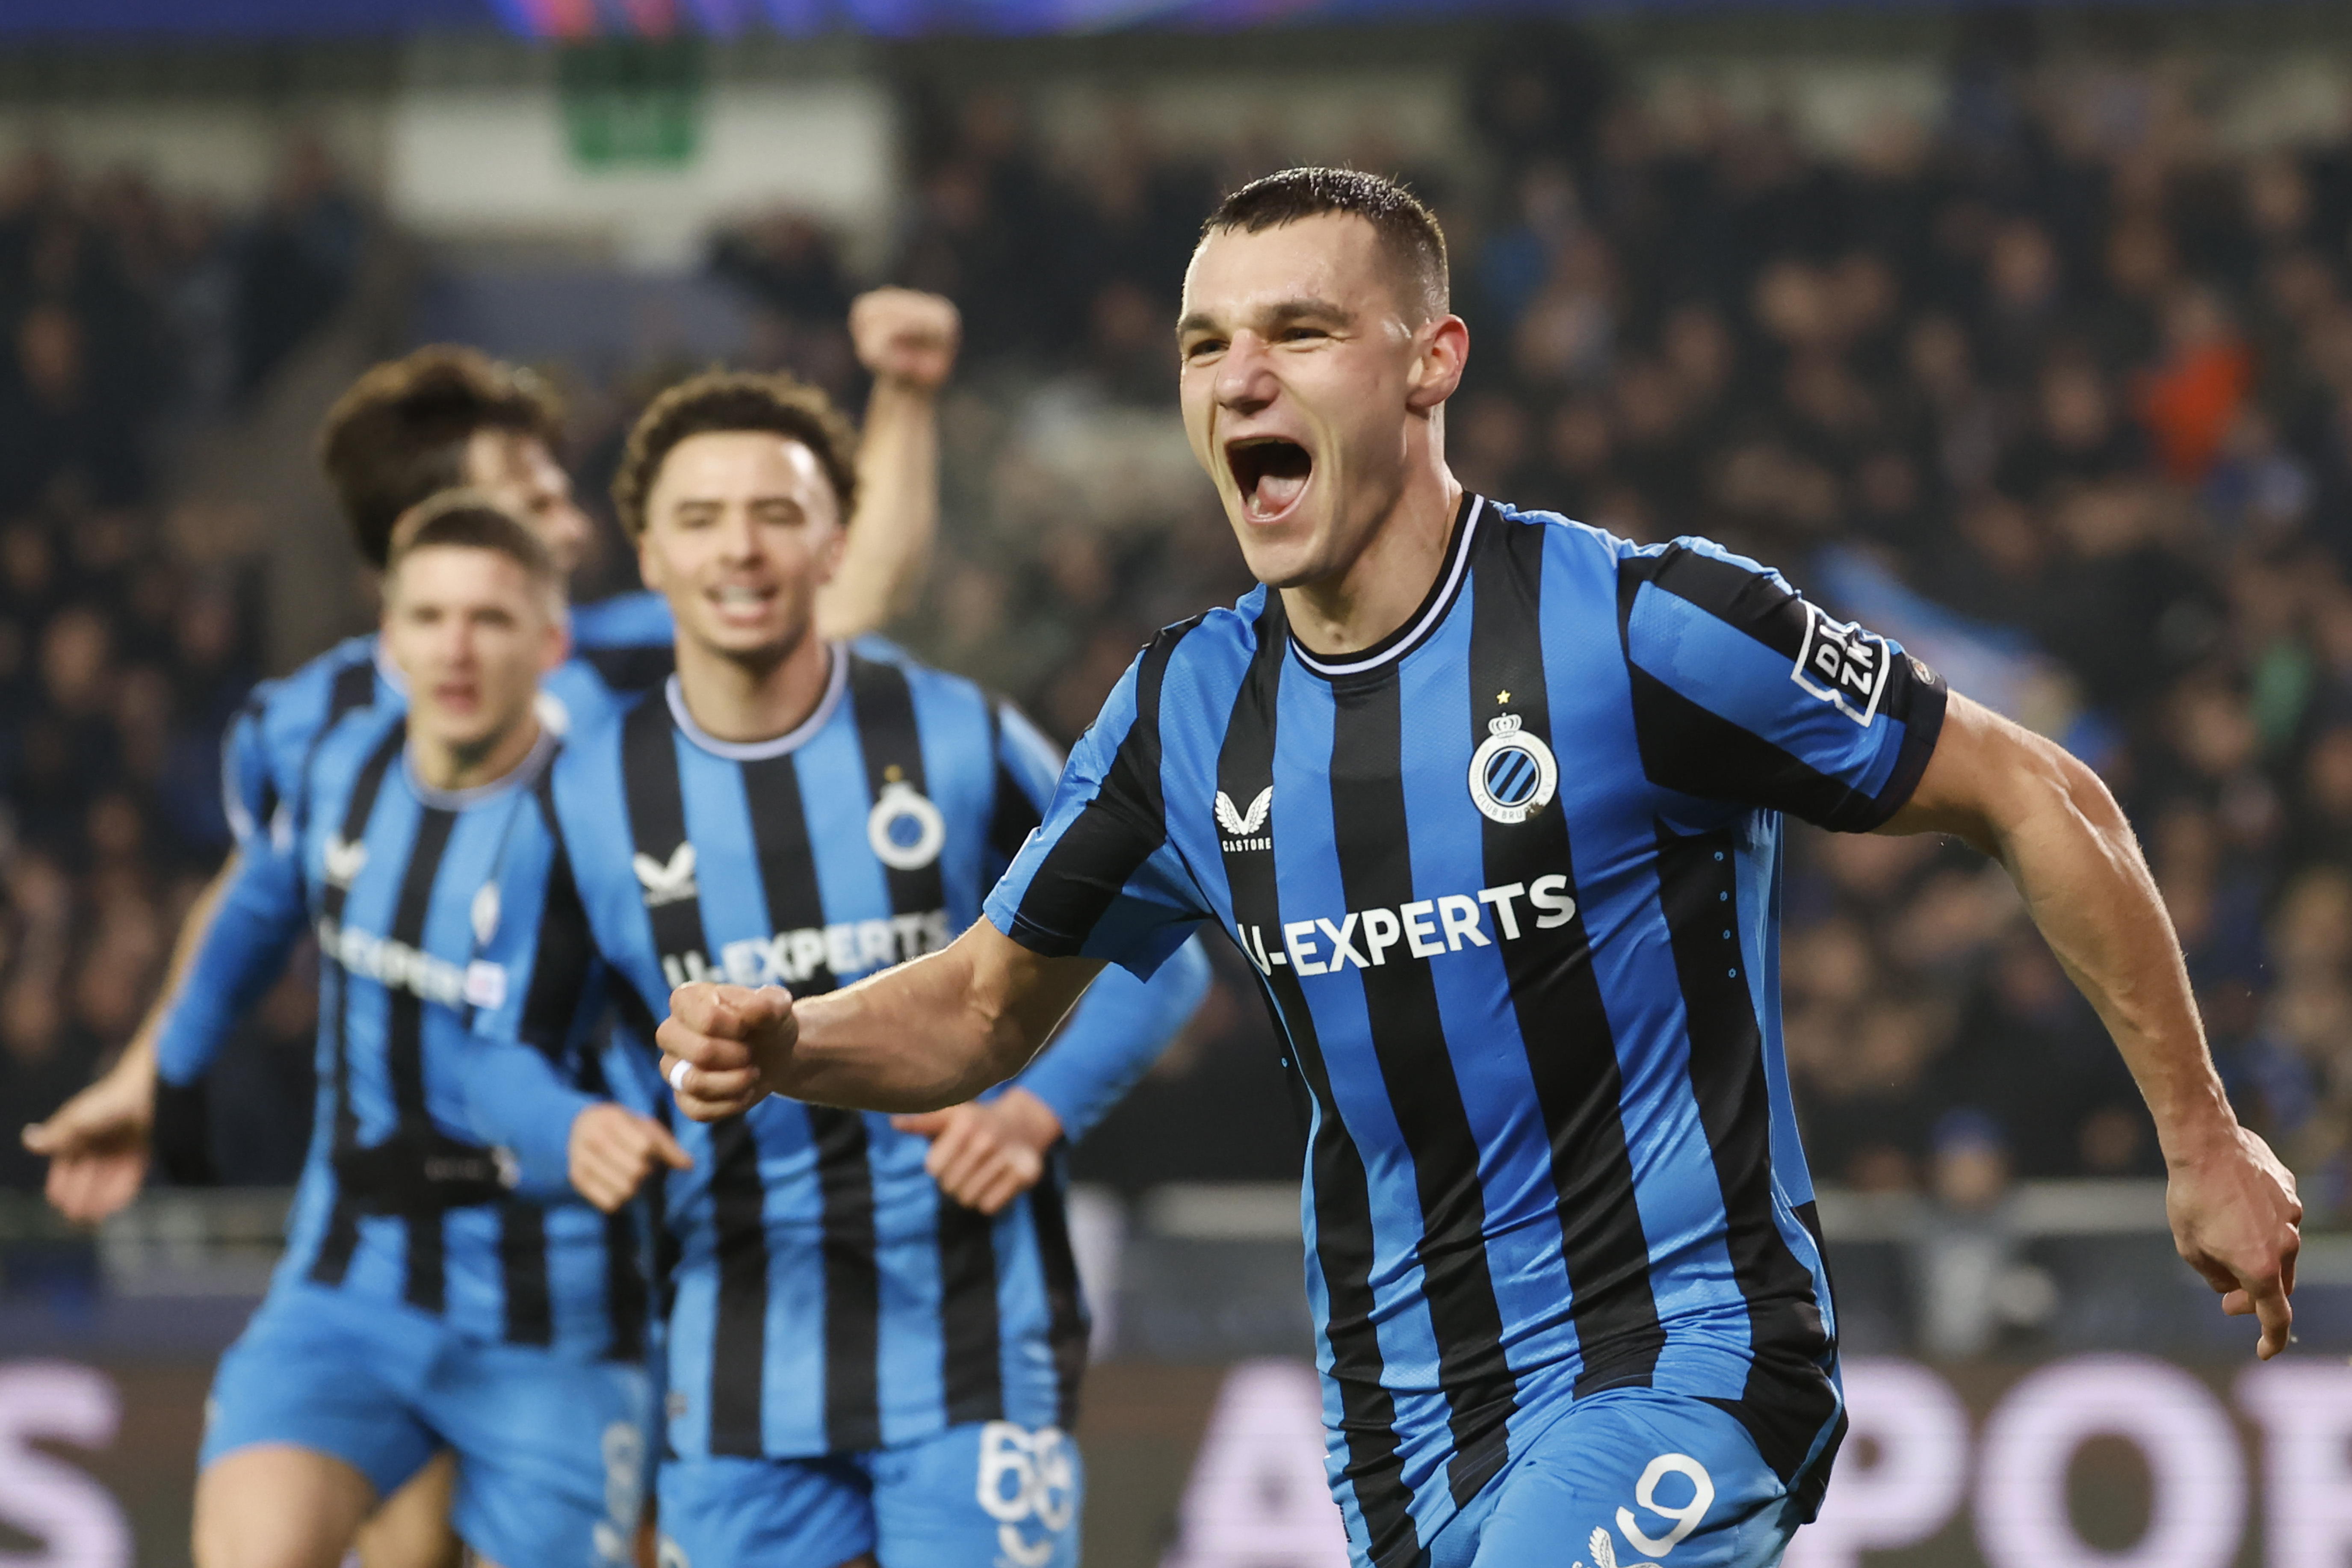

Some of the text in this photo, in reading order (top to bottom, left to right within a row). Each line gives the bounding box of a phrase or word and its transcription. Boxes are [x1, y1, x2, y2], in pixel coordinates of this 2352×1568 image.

[1477, 793, 1498, 816] CLUB
[1222, 837, 1271, 852] CASTORE
[1237, 874, 1576, 976] U-EXPERTS
[1616, 1453, 1714, 1557] 9
